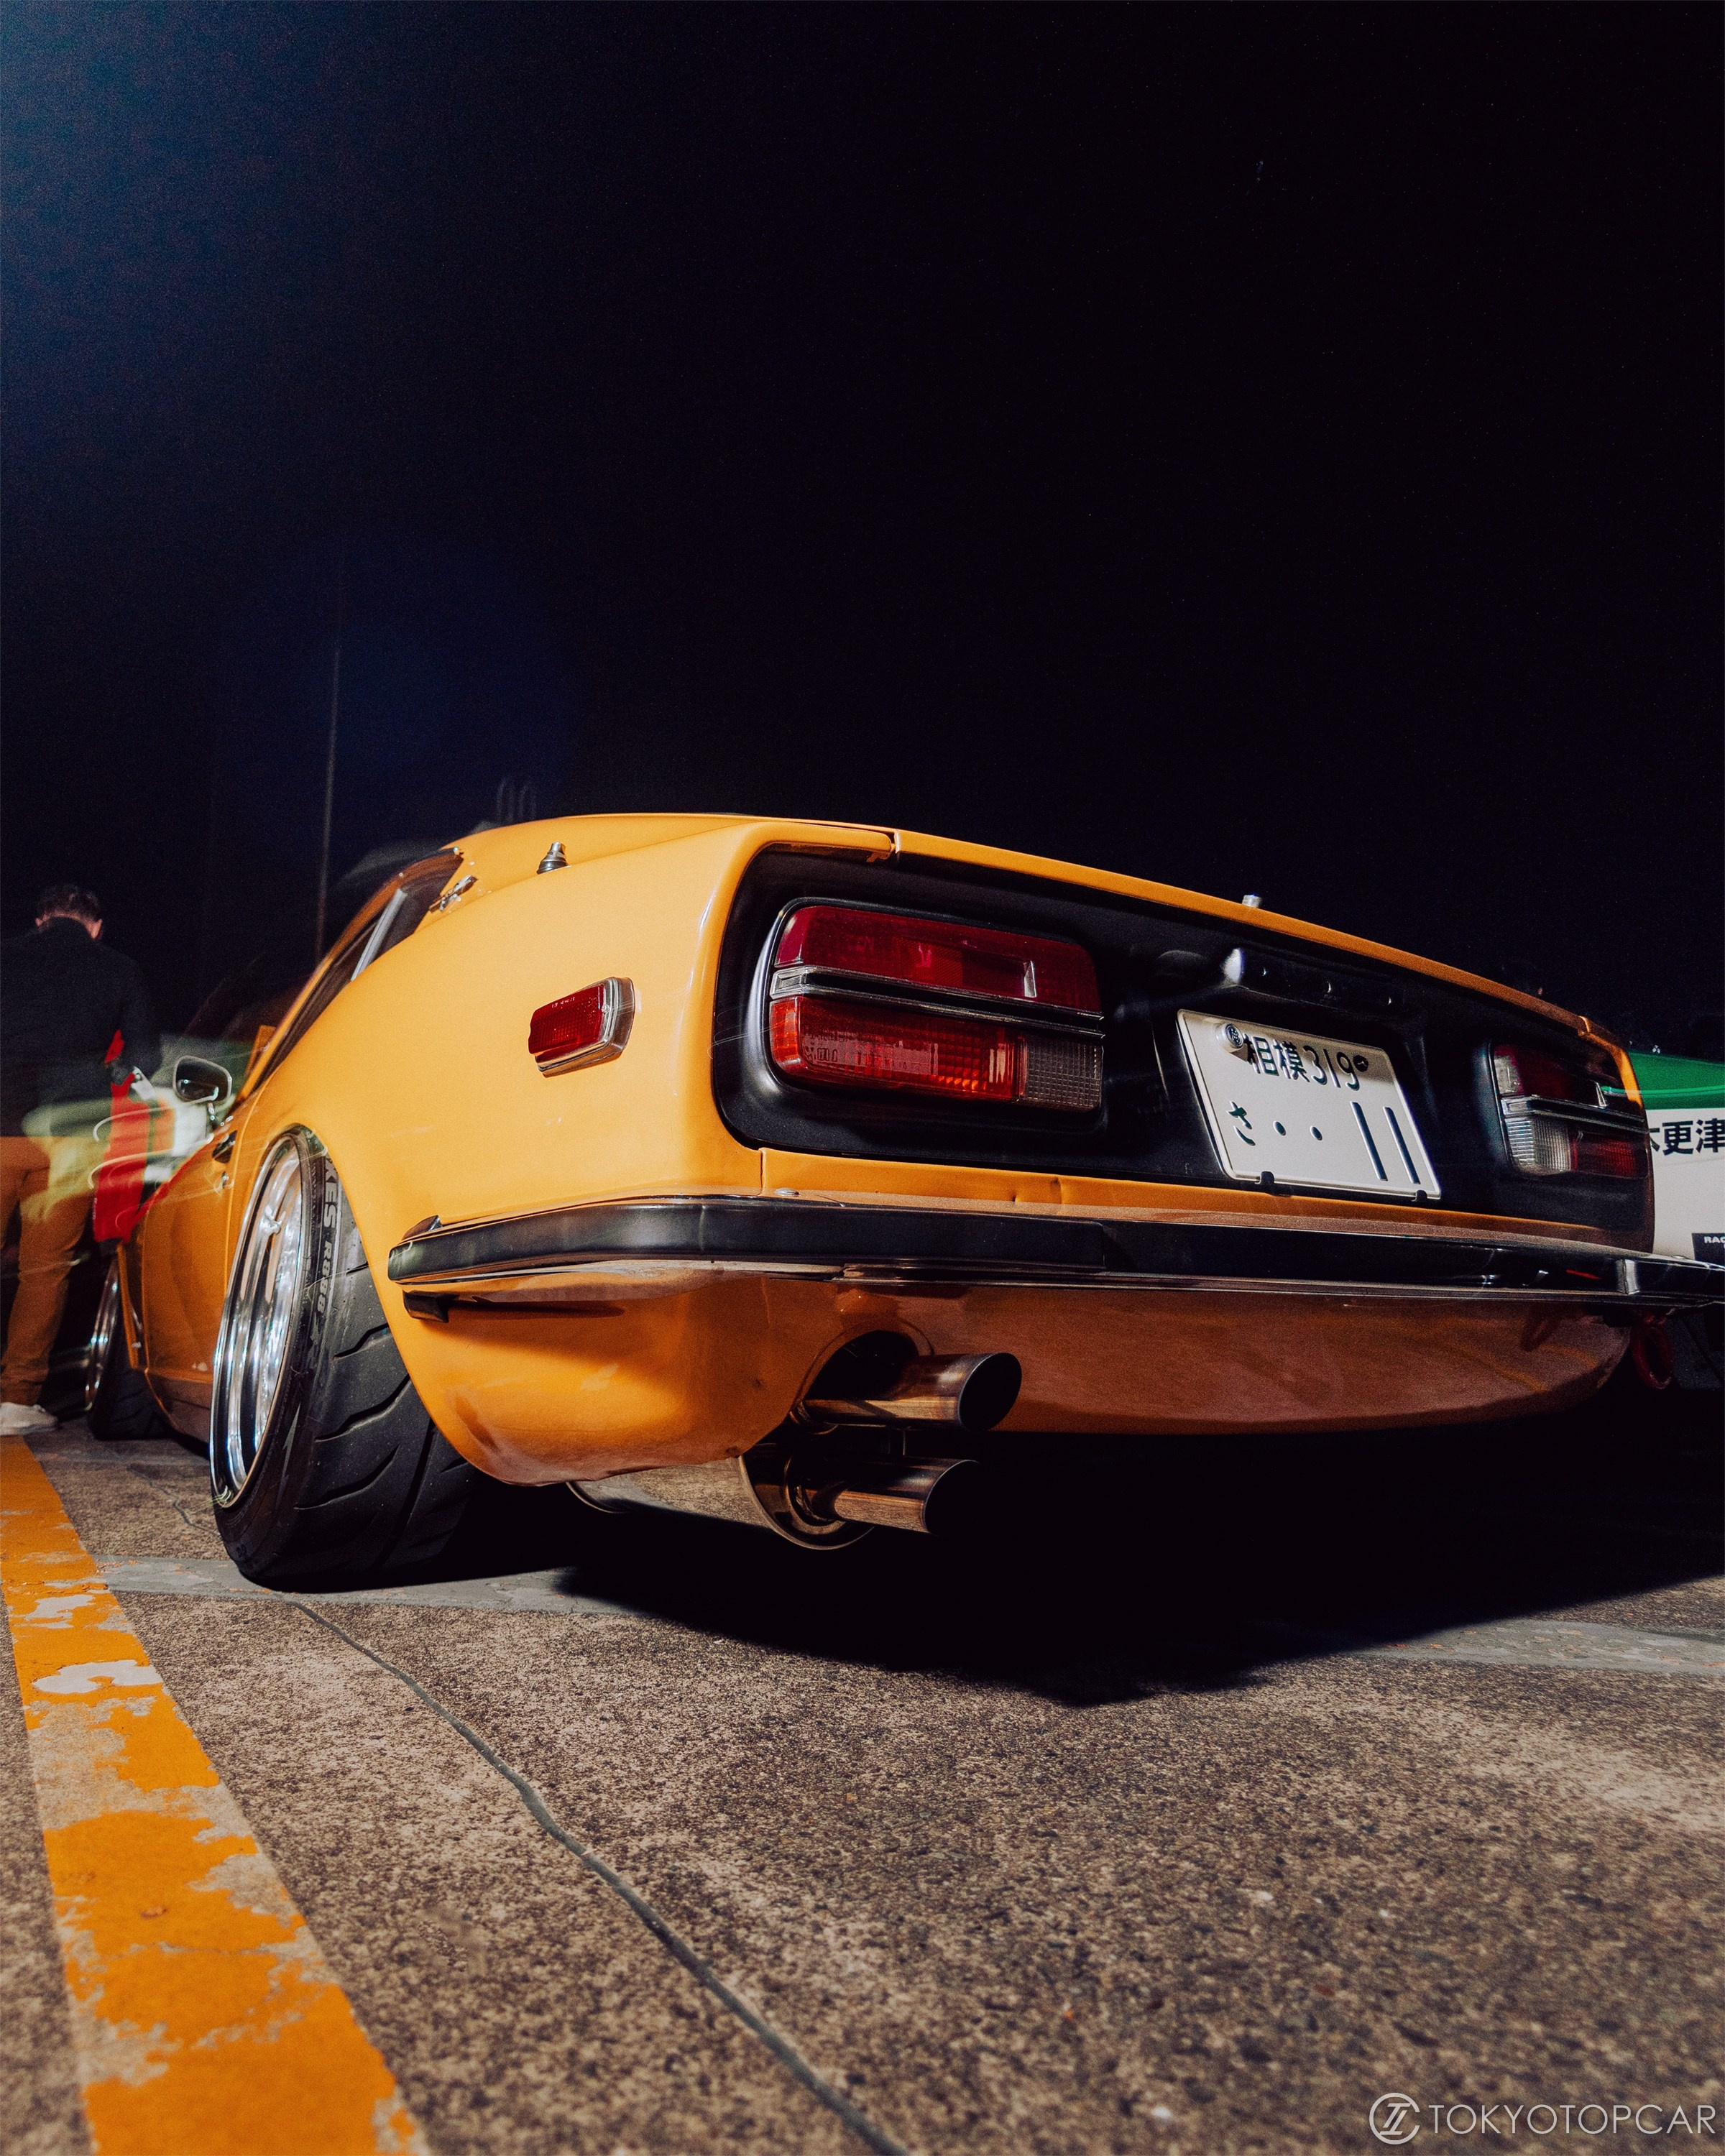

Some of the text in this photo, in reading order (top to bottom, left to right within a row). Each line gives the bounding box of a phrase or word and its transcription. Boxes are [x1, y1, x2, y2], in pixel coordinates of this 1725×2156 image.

[1227, 1101, 1256, 1146] さ
[317, 1154, 339, 1314] XES R888
